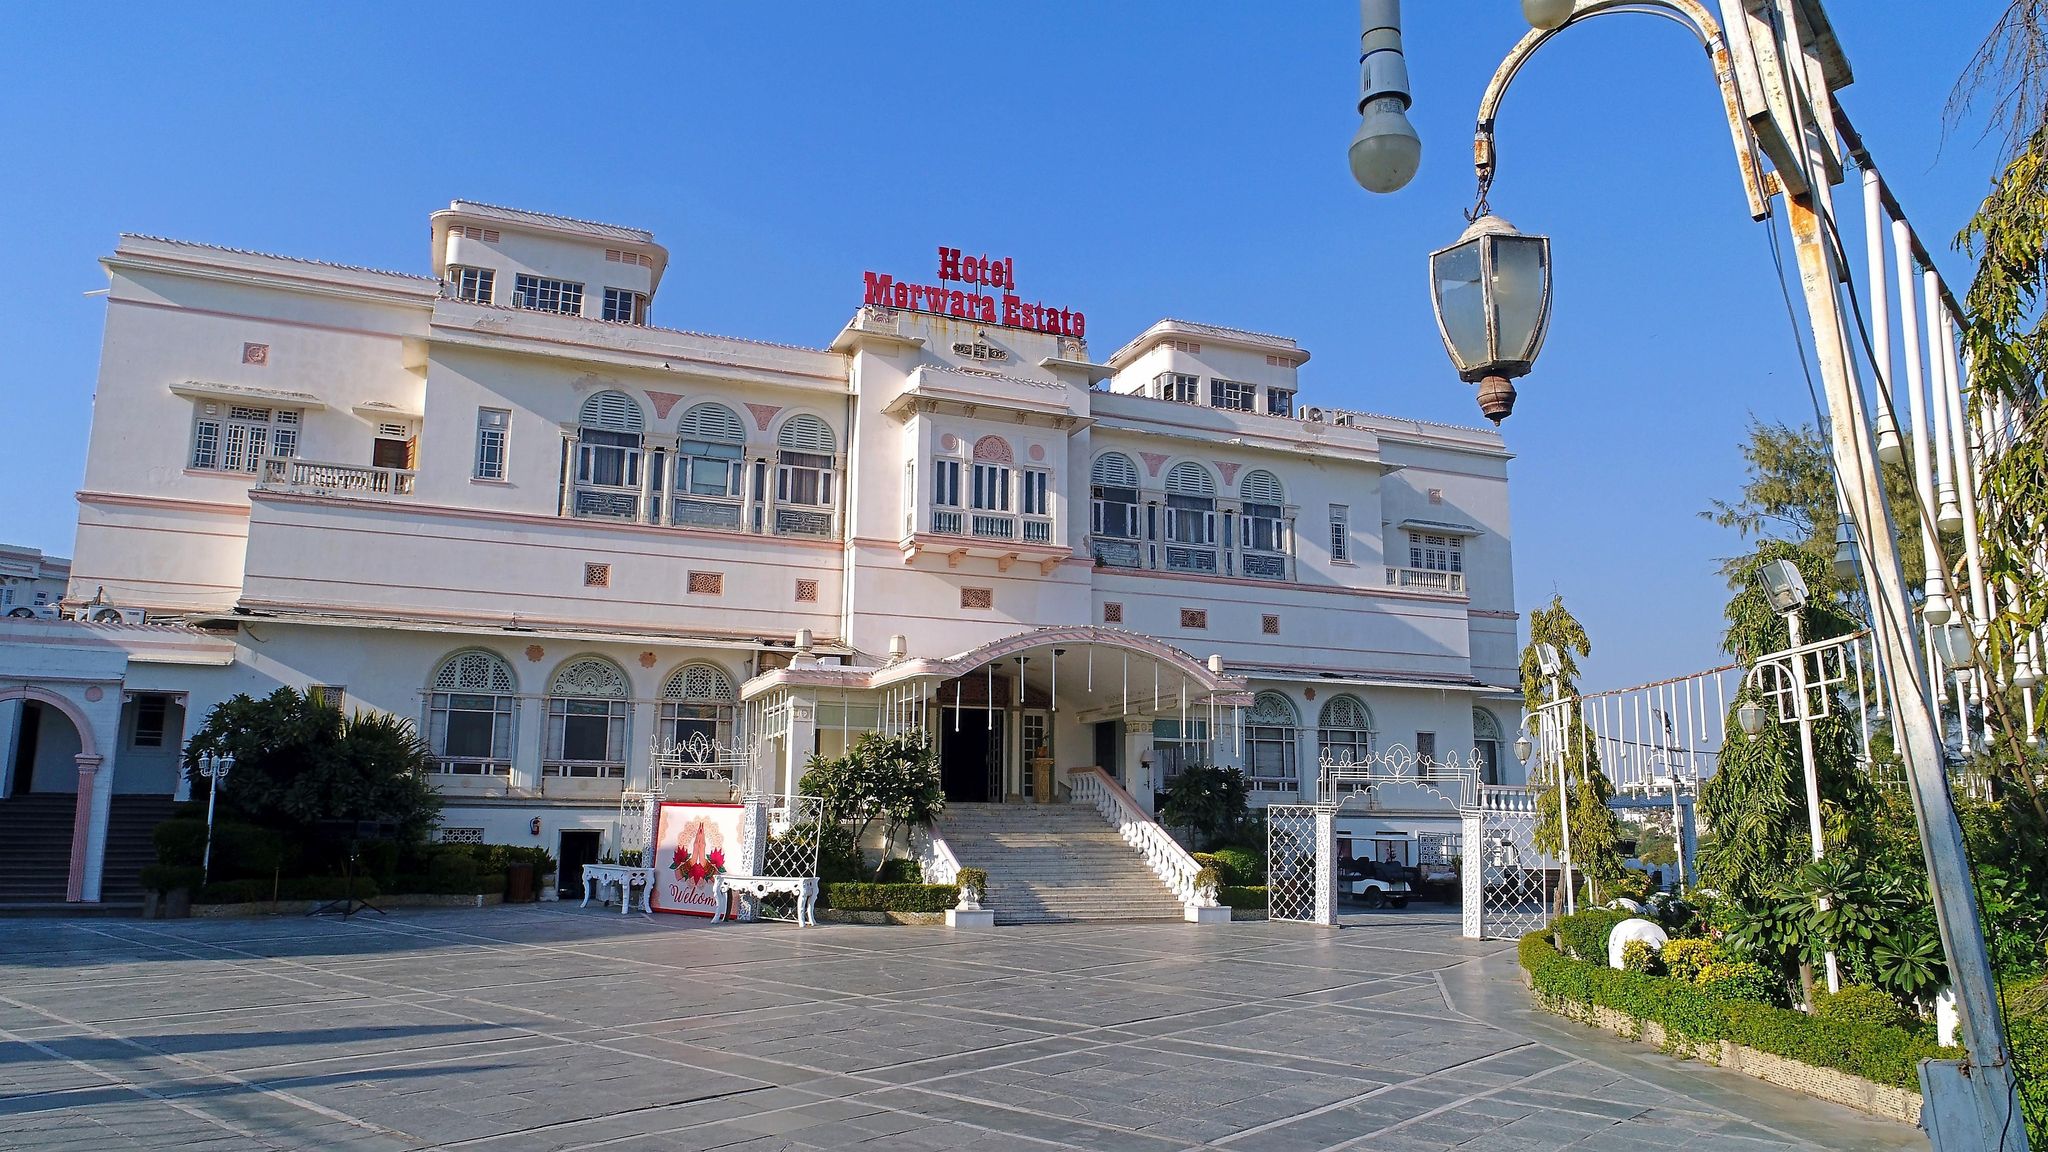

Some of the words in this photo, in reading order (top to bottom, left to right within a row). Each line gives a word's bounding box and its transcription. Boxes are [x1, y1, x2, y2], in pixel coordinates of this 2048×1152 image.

[939, 247, 1014, 290] Hotel
[863, 271, 997, 324] Merwara
[1003, 294, 1085, 338] Estate
[669, 884, 717, 907] Welcom
